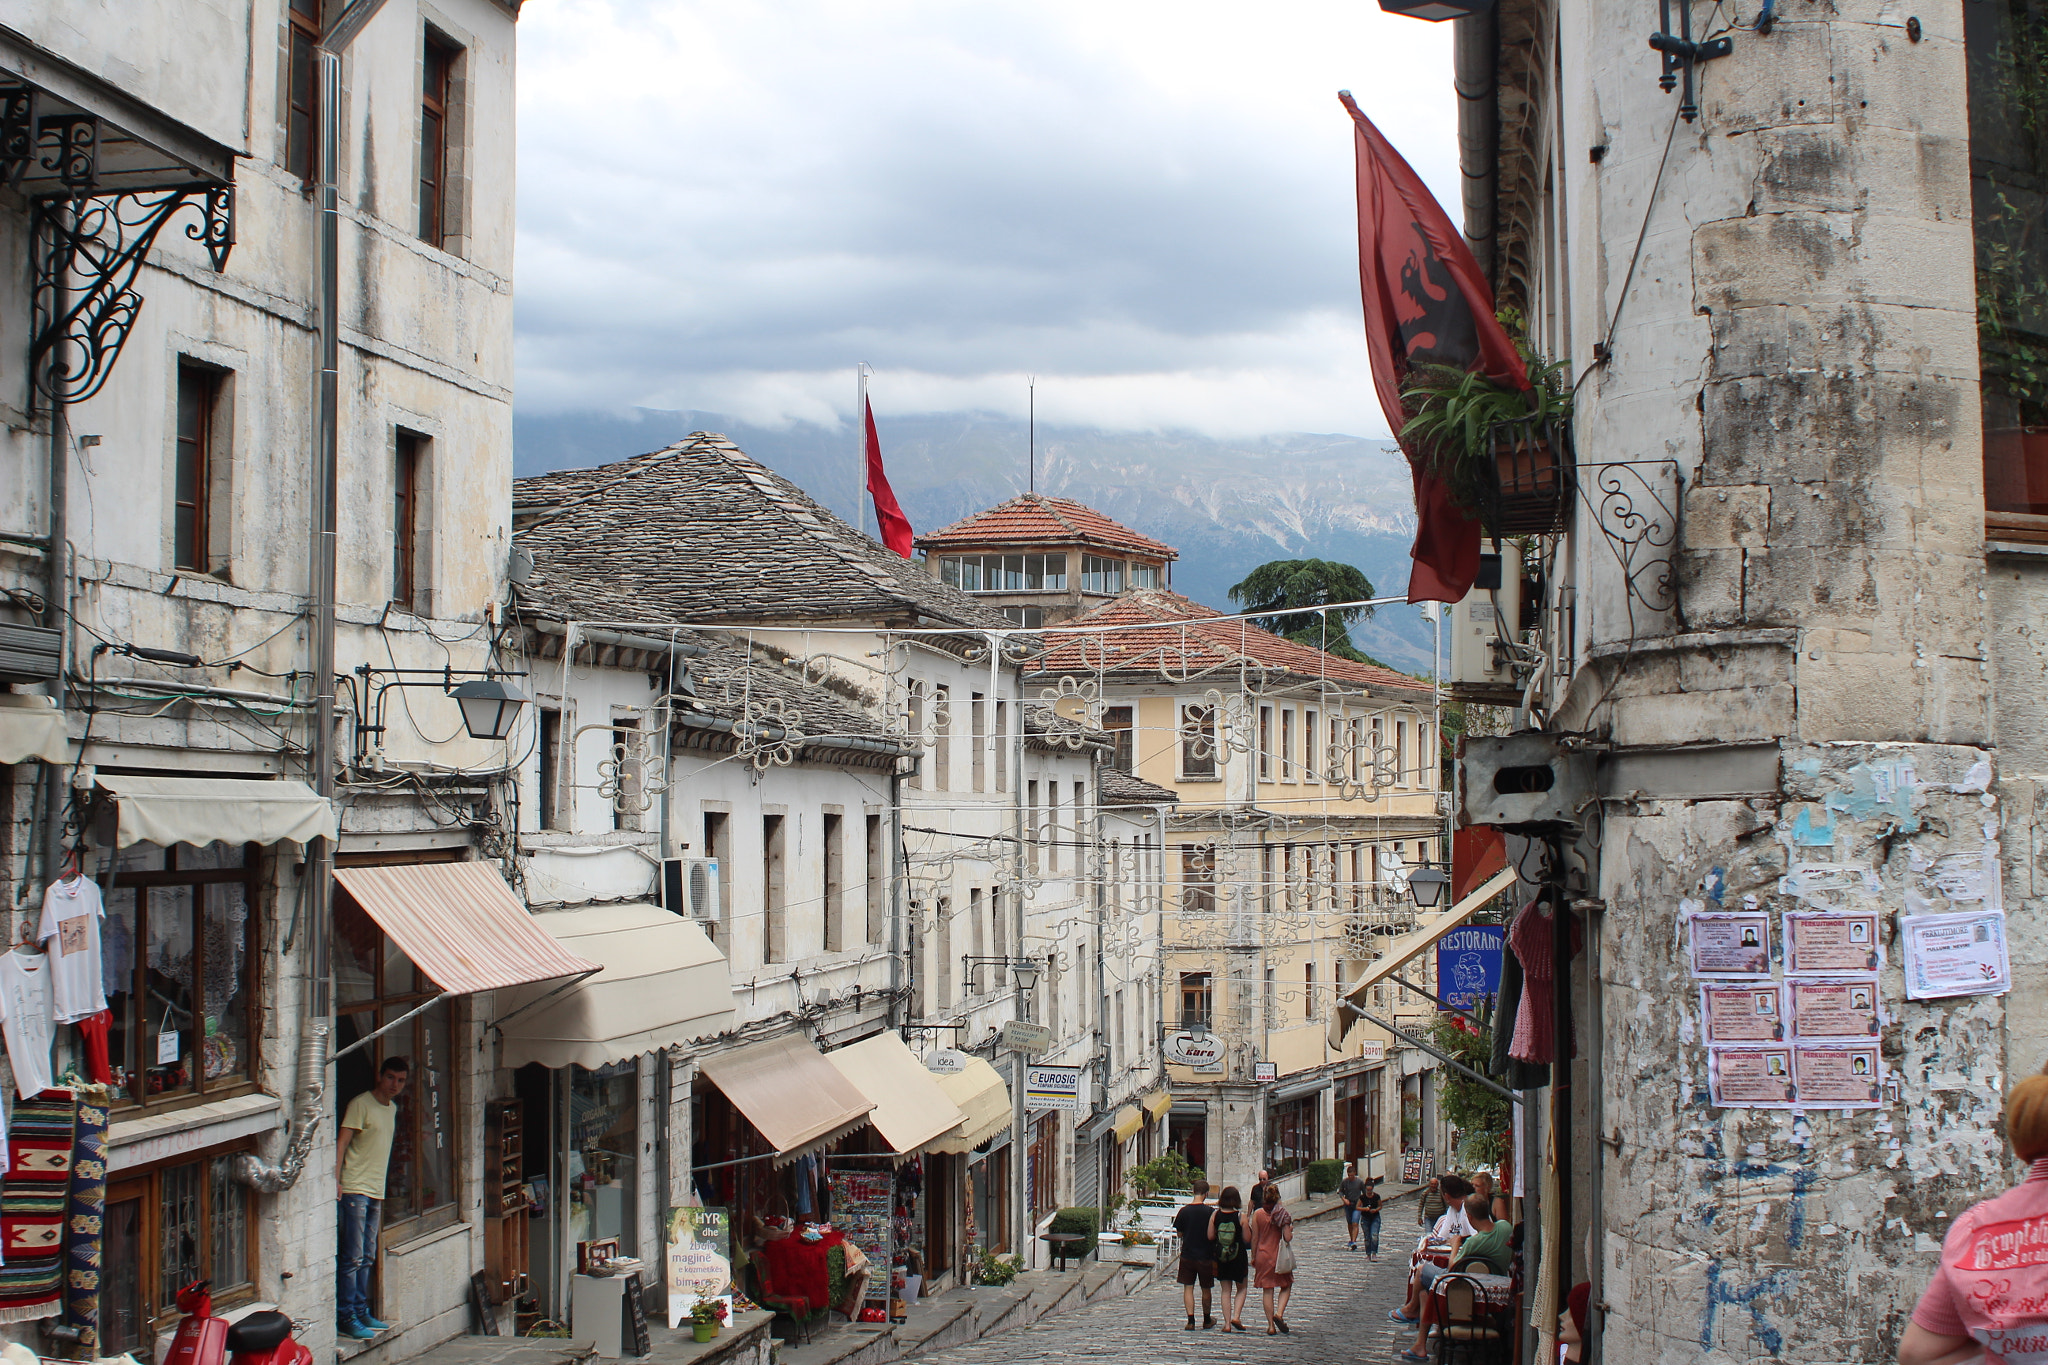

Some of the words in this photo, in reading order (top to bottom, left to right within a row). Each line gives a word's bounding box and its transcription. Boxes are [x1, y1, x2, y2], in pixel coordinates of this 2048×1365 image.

[1440, 931, 1503, 950] RESTORANT
[1364, 1047, 1383, 1056] SOPOTI
[937, 1056, 954, 1066] idea
[1038, 1073, 1076, 1084] EUROSIG
[424, 1028, 444, 1149] BERBER
[695, 1212, 721, 1224] HYR
[702, 1227, 719, 1237] dhe
[689, 1240, 717, 1251] zbulo
[672, 1253, 711, 1265] magjinë
[684, 1265, 723, 1273] kozmetikës
